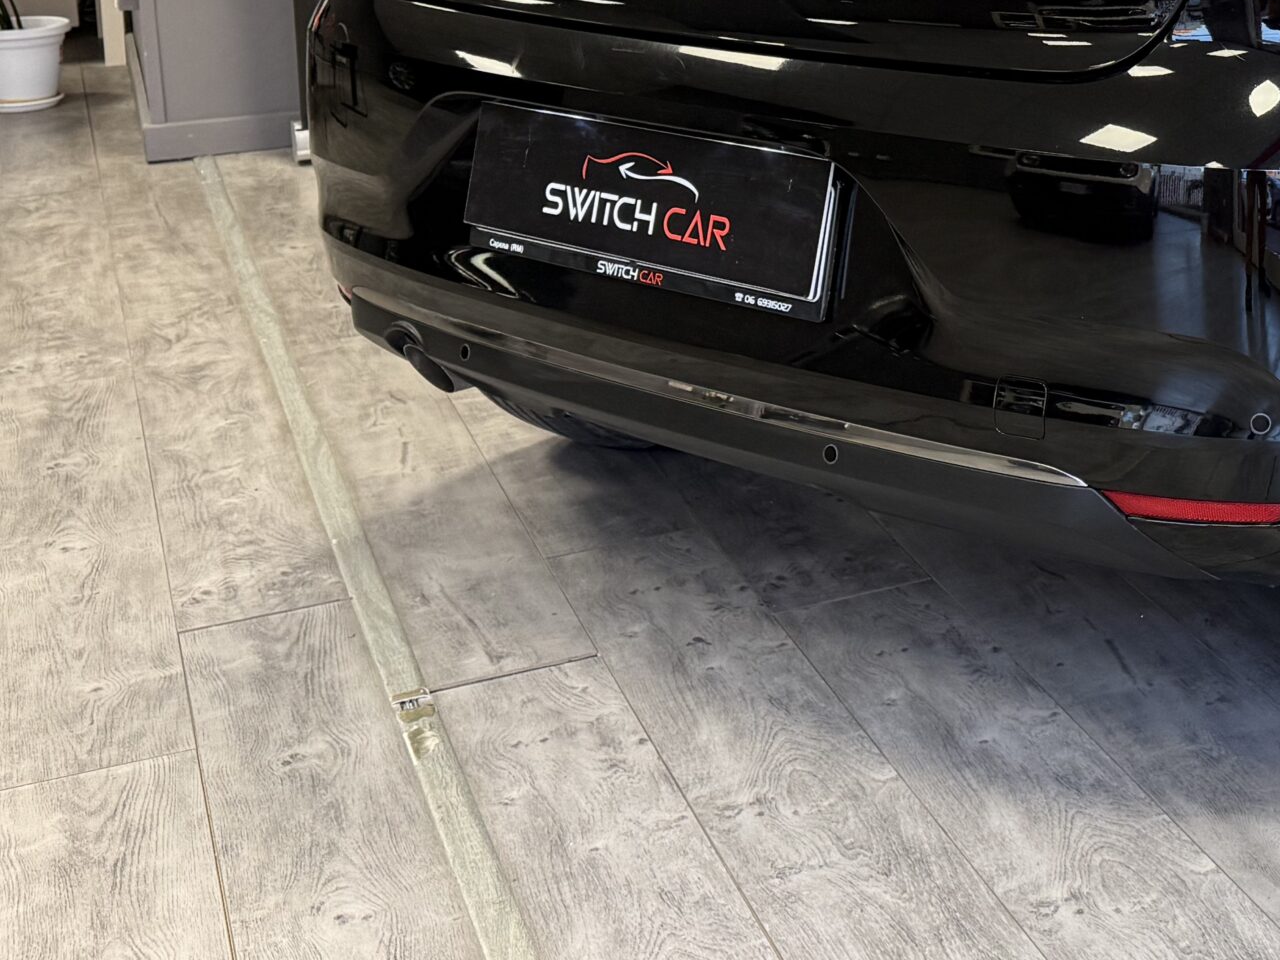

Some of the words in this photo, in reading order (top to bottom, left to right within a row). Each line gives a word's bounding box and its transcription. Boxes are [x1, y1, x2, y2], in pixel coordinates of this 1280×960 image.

[542, 182, 658, 235] SWITCH
[663, 207, 731, 251] CAR
[596, 260, 639, 281] SWITCH
[639, 270, 664, 286] CAR
[744, 294, 756, 305] 06
